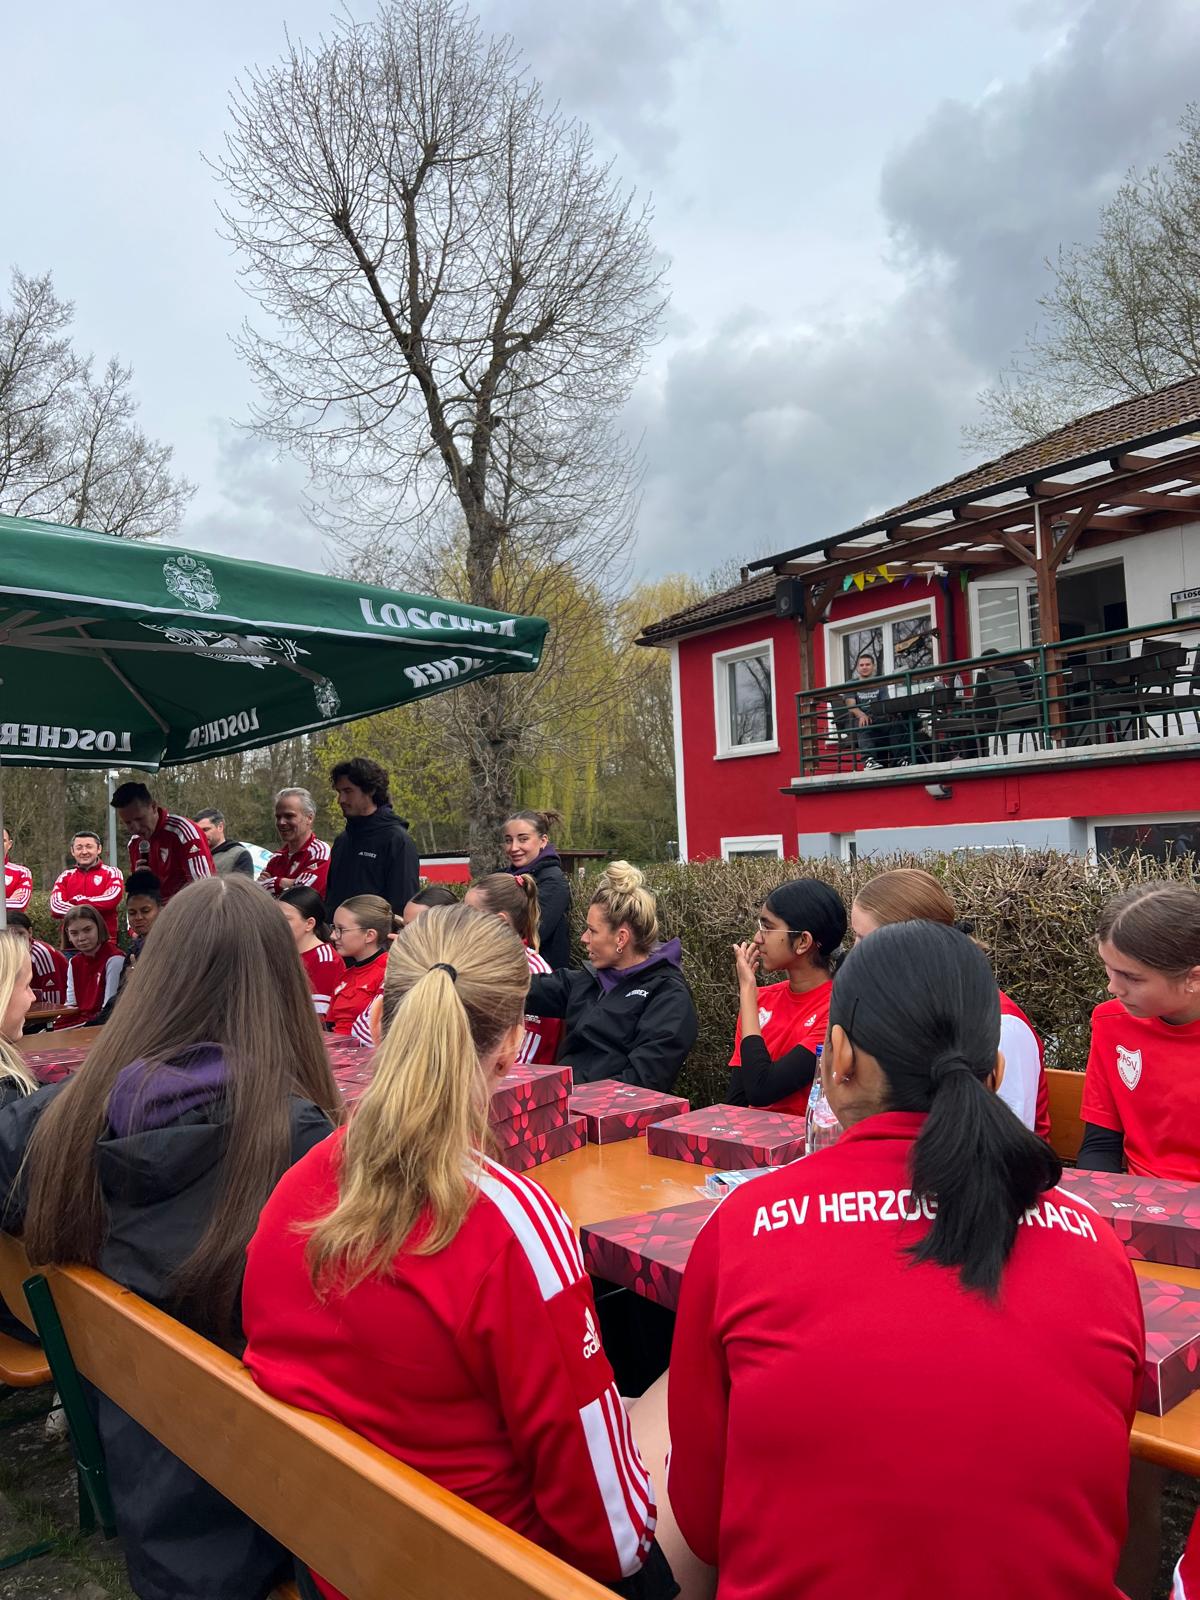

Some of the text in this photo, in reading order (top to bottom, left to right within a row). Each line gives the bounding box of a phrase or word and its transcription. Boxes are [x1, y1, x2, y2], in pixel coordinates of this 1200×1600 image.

[1121, 1053, 1138, 1071] ASV
[752, 1189, 1098, 1243] ASV HERZOGRACH
